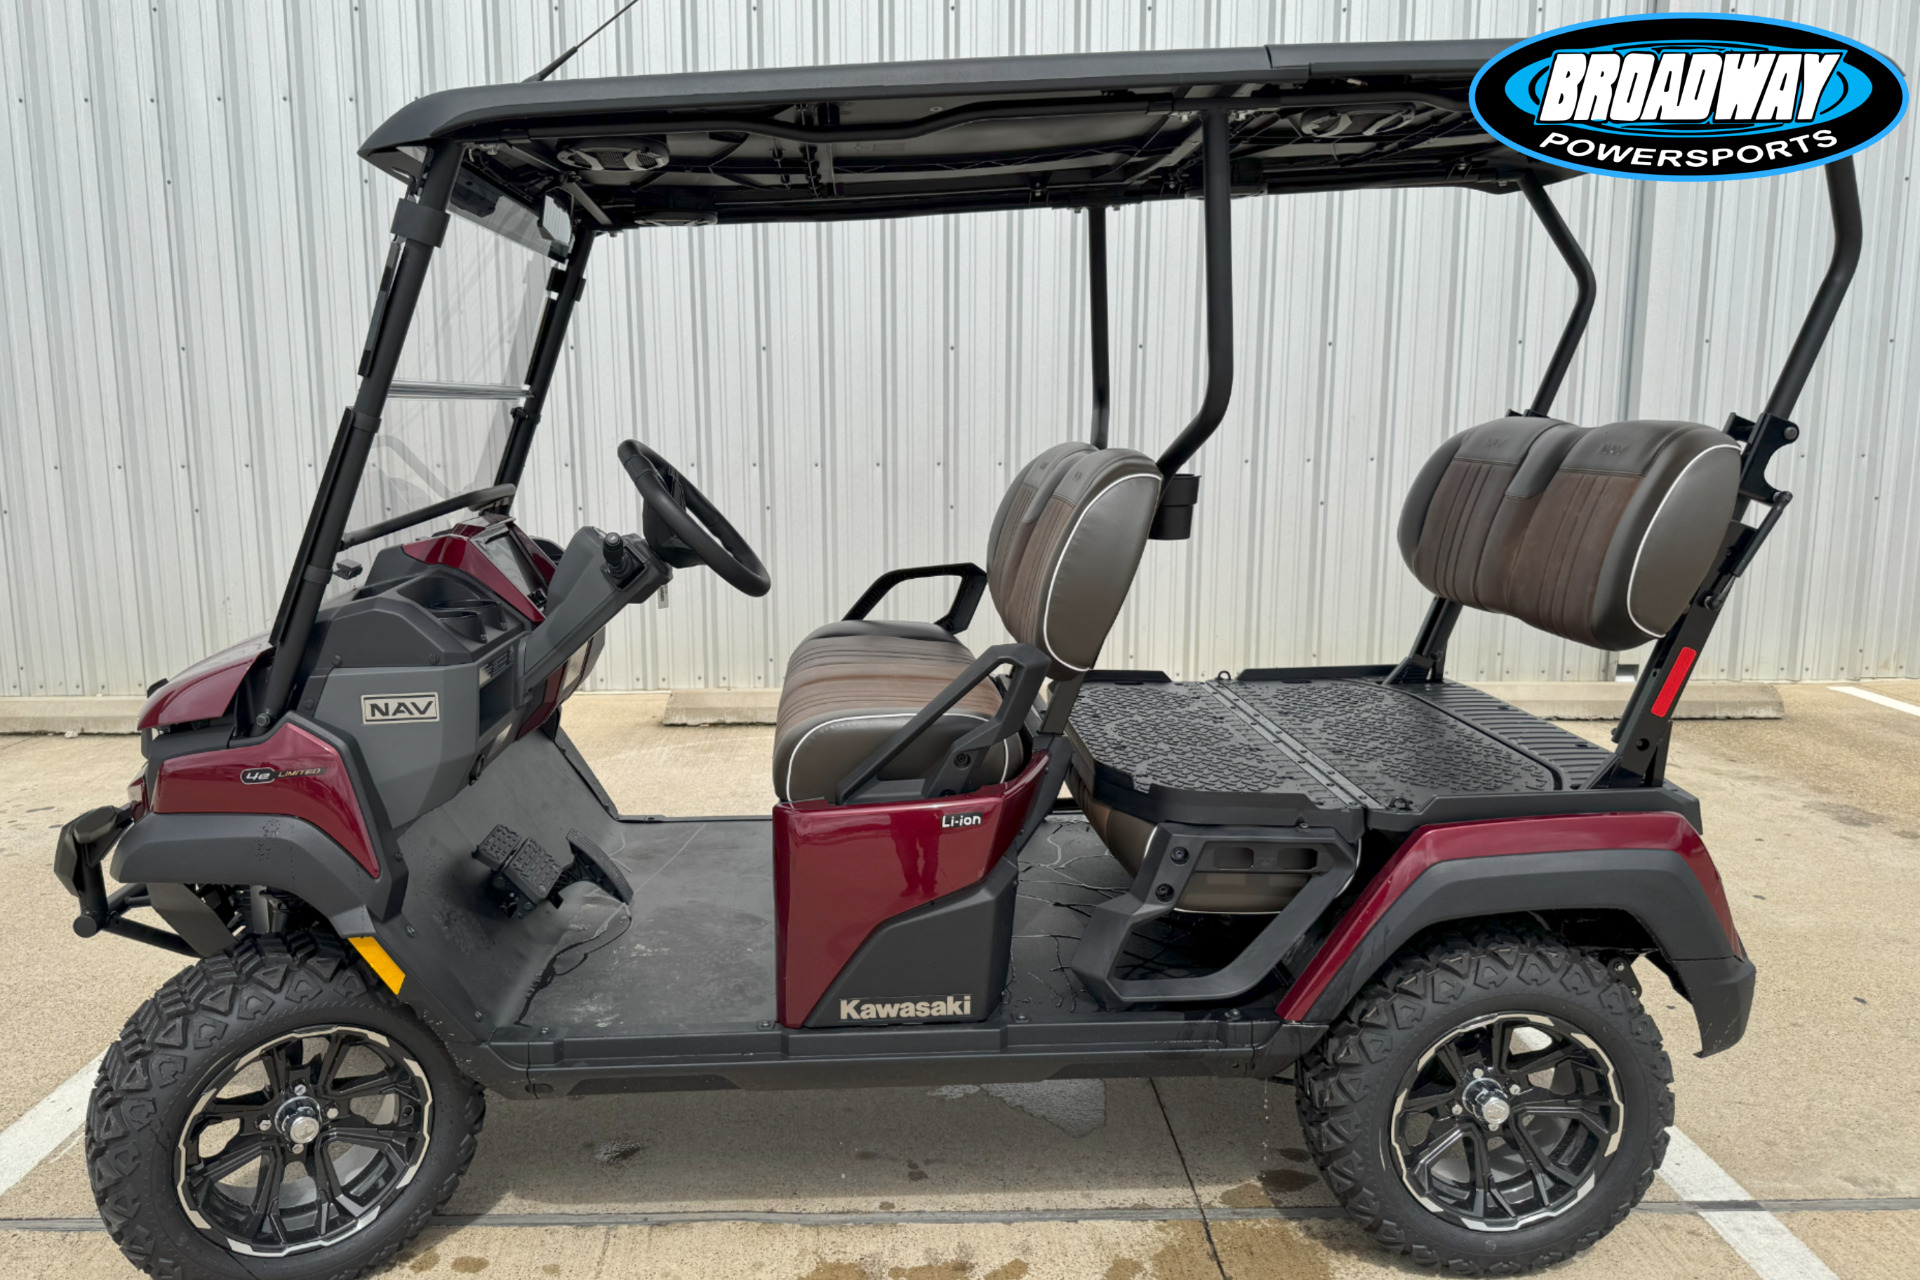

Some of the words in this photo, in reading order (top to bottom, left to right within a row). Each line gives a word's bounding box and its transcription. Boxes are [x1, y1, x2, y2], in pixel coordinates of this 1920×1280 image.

[369, 700, 434, 718] NAV
[246, 771, 271, 781] 4e
[278, 767, 321, 778] LIMITED
[941, 814, 982, 828] Li-ion
[839, 995, 971, 1020] Kawasaki
